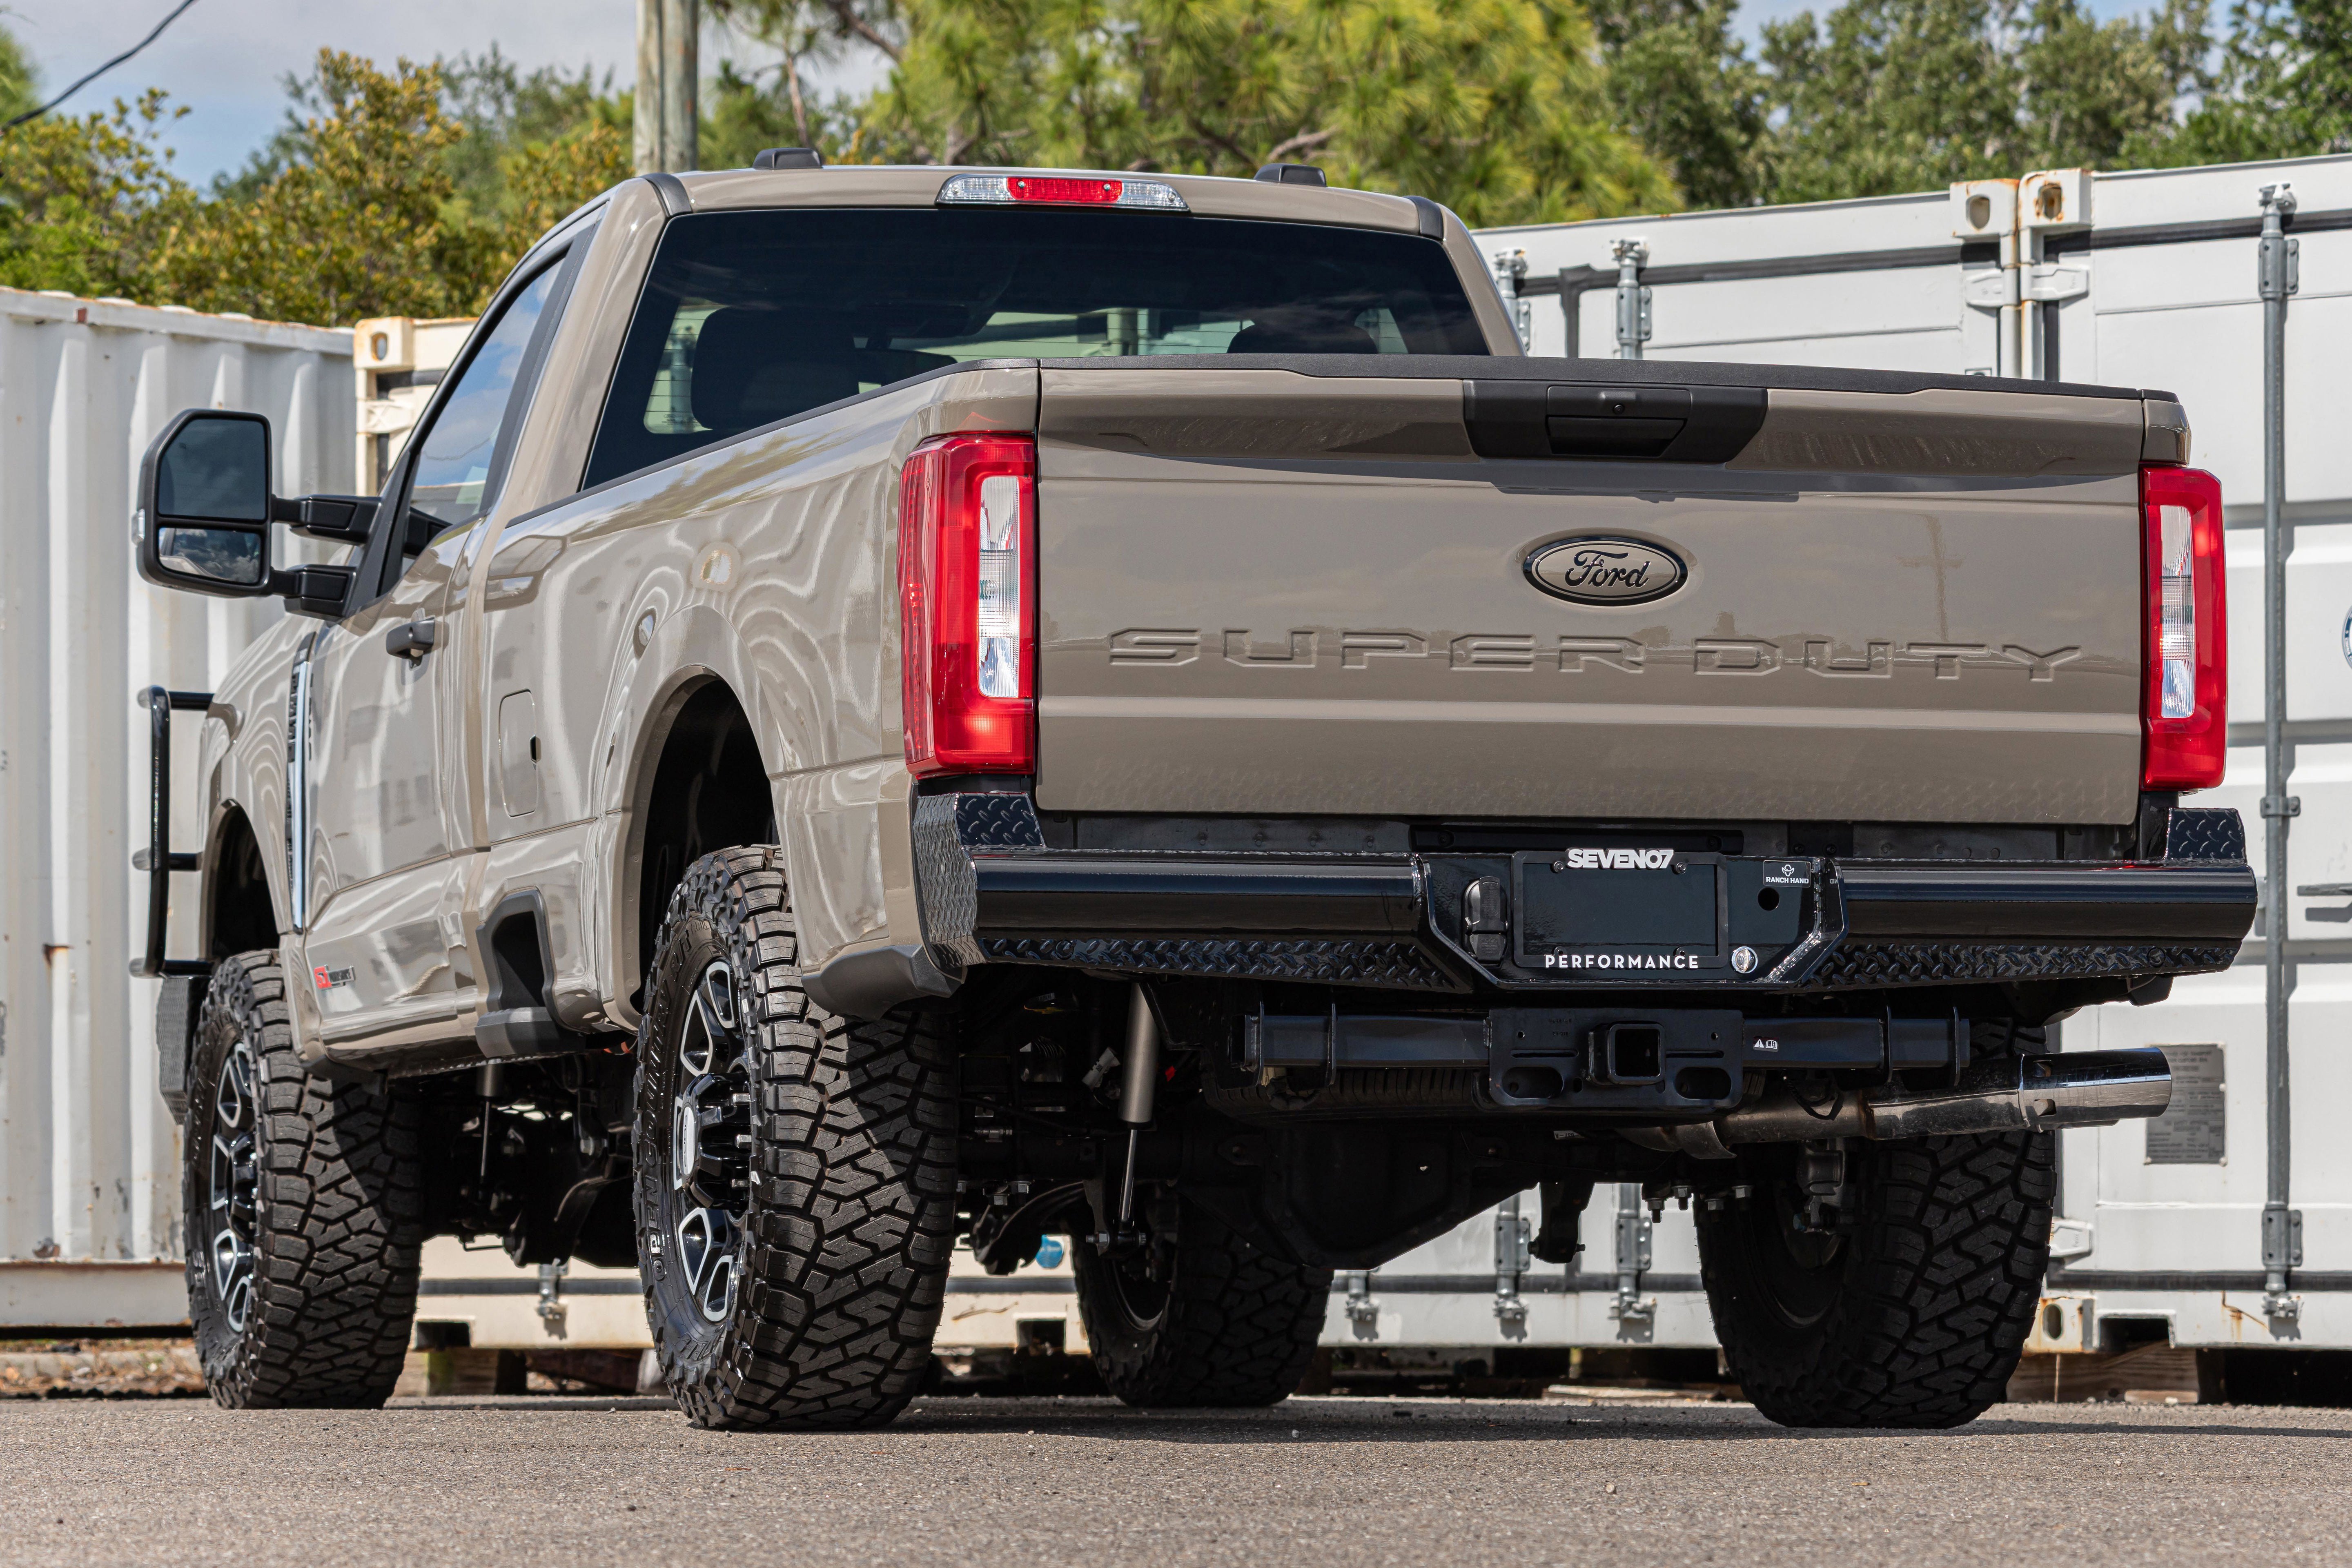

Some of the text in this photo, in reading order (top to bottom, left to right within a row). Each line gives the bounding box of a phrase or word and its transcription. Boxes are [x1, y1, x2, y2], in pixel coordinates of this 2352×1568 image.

[1565, 550, 1650, 588] Ford
[1109, 627, 2083, 682] SUPER DUTY
[1545, 954, 1698, 969] PERFORMANCE
[645, 1175, 666, 1281] OPEN
